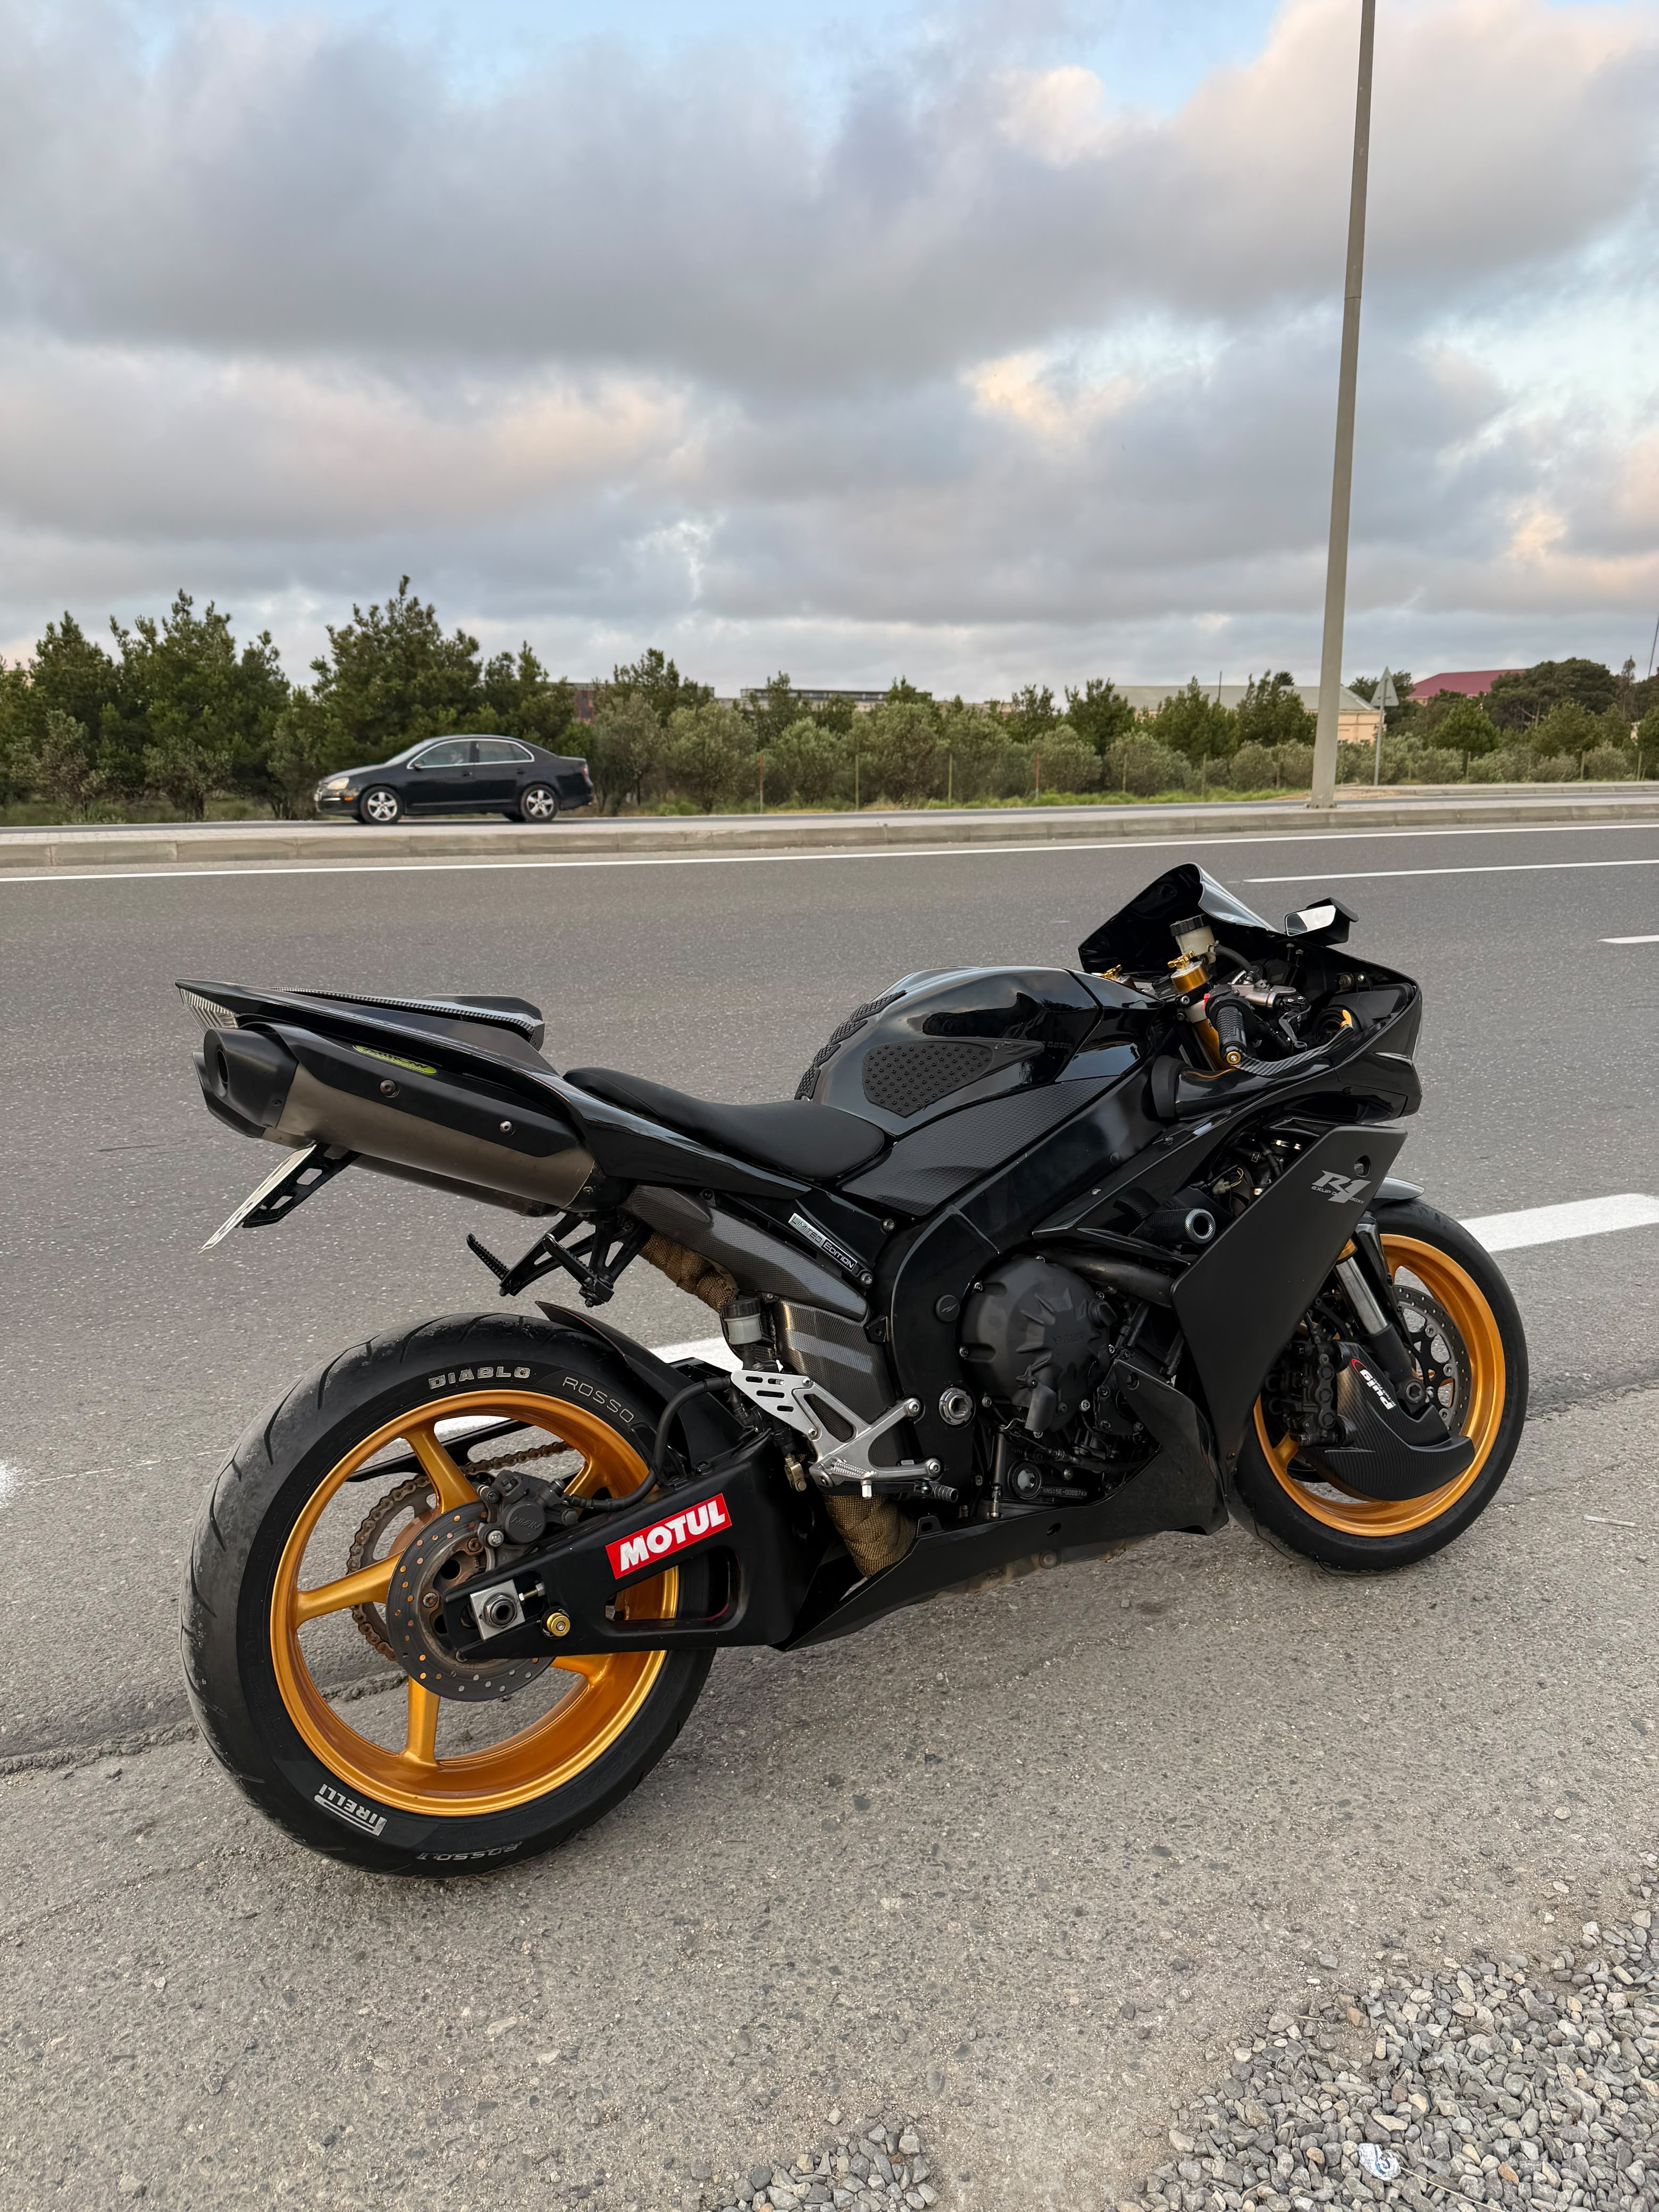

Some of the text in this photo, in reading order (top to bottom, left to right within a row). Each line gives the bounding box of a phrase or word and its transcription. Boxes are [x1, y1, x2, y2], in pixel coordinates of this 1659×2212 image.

[1311, 1170, 1372, 1203] R1
[792, 1215, 855, 1268] LIMITED EDITION
[428, 1366, 635, 1423] DIABLO ROSSO
[1360, 1369, 1394, 1410] Puig
[620, 1500, 725, 1572] MOTUL
[314, 1783, 387, 1837] PIRELLI
